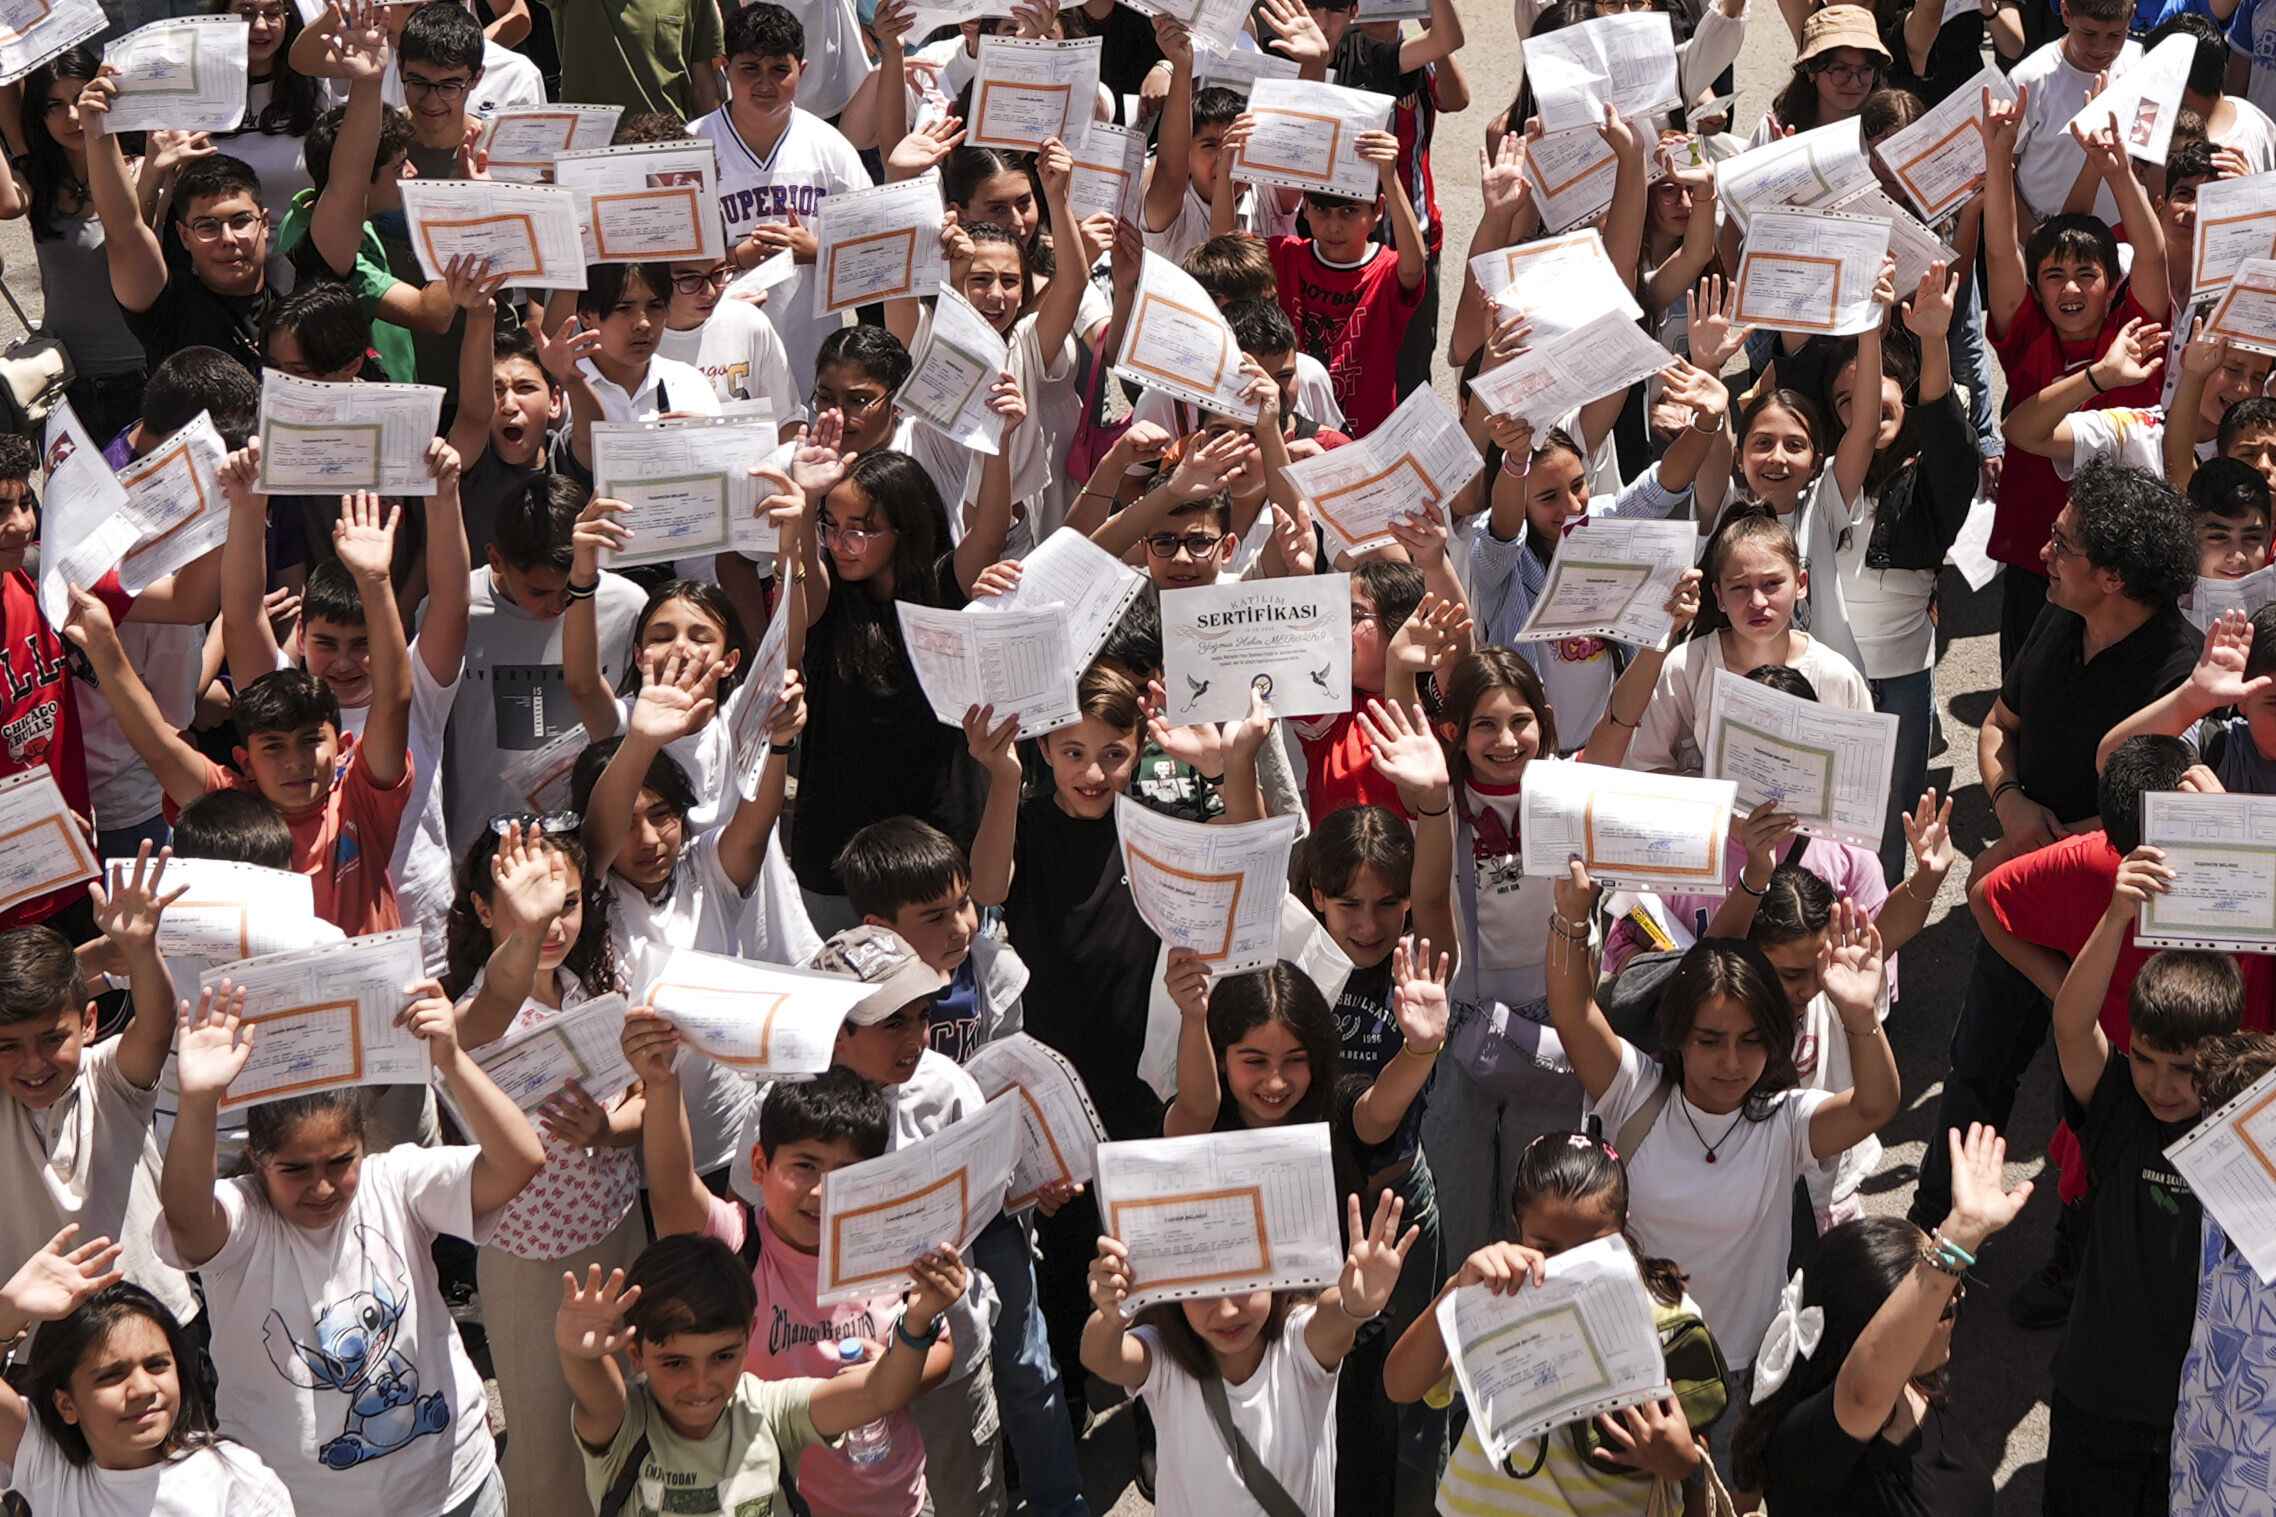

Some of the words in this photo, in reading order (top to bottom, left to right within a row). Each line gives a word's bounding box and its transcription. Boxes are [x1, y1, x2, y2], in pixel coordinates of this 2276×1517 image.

[1197, 604, 1317, 629] SERTİFİKASI
[3, 702, 57, 738] CHICAGO
[14, 717, 52, 747] BULLS
[666, 1472, 697, 1486] TODAY
